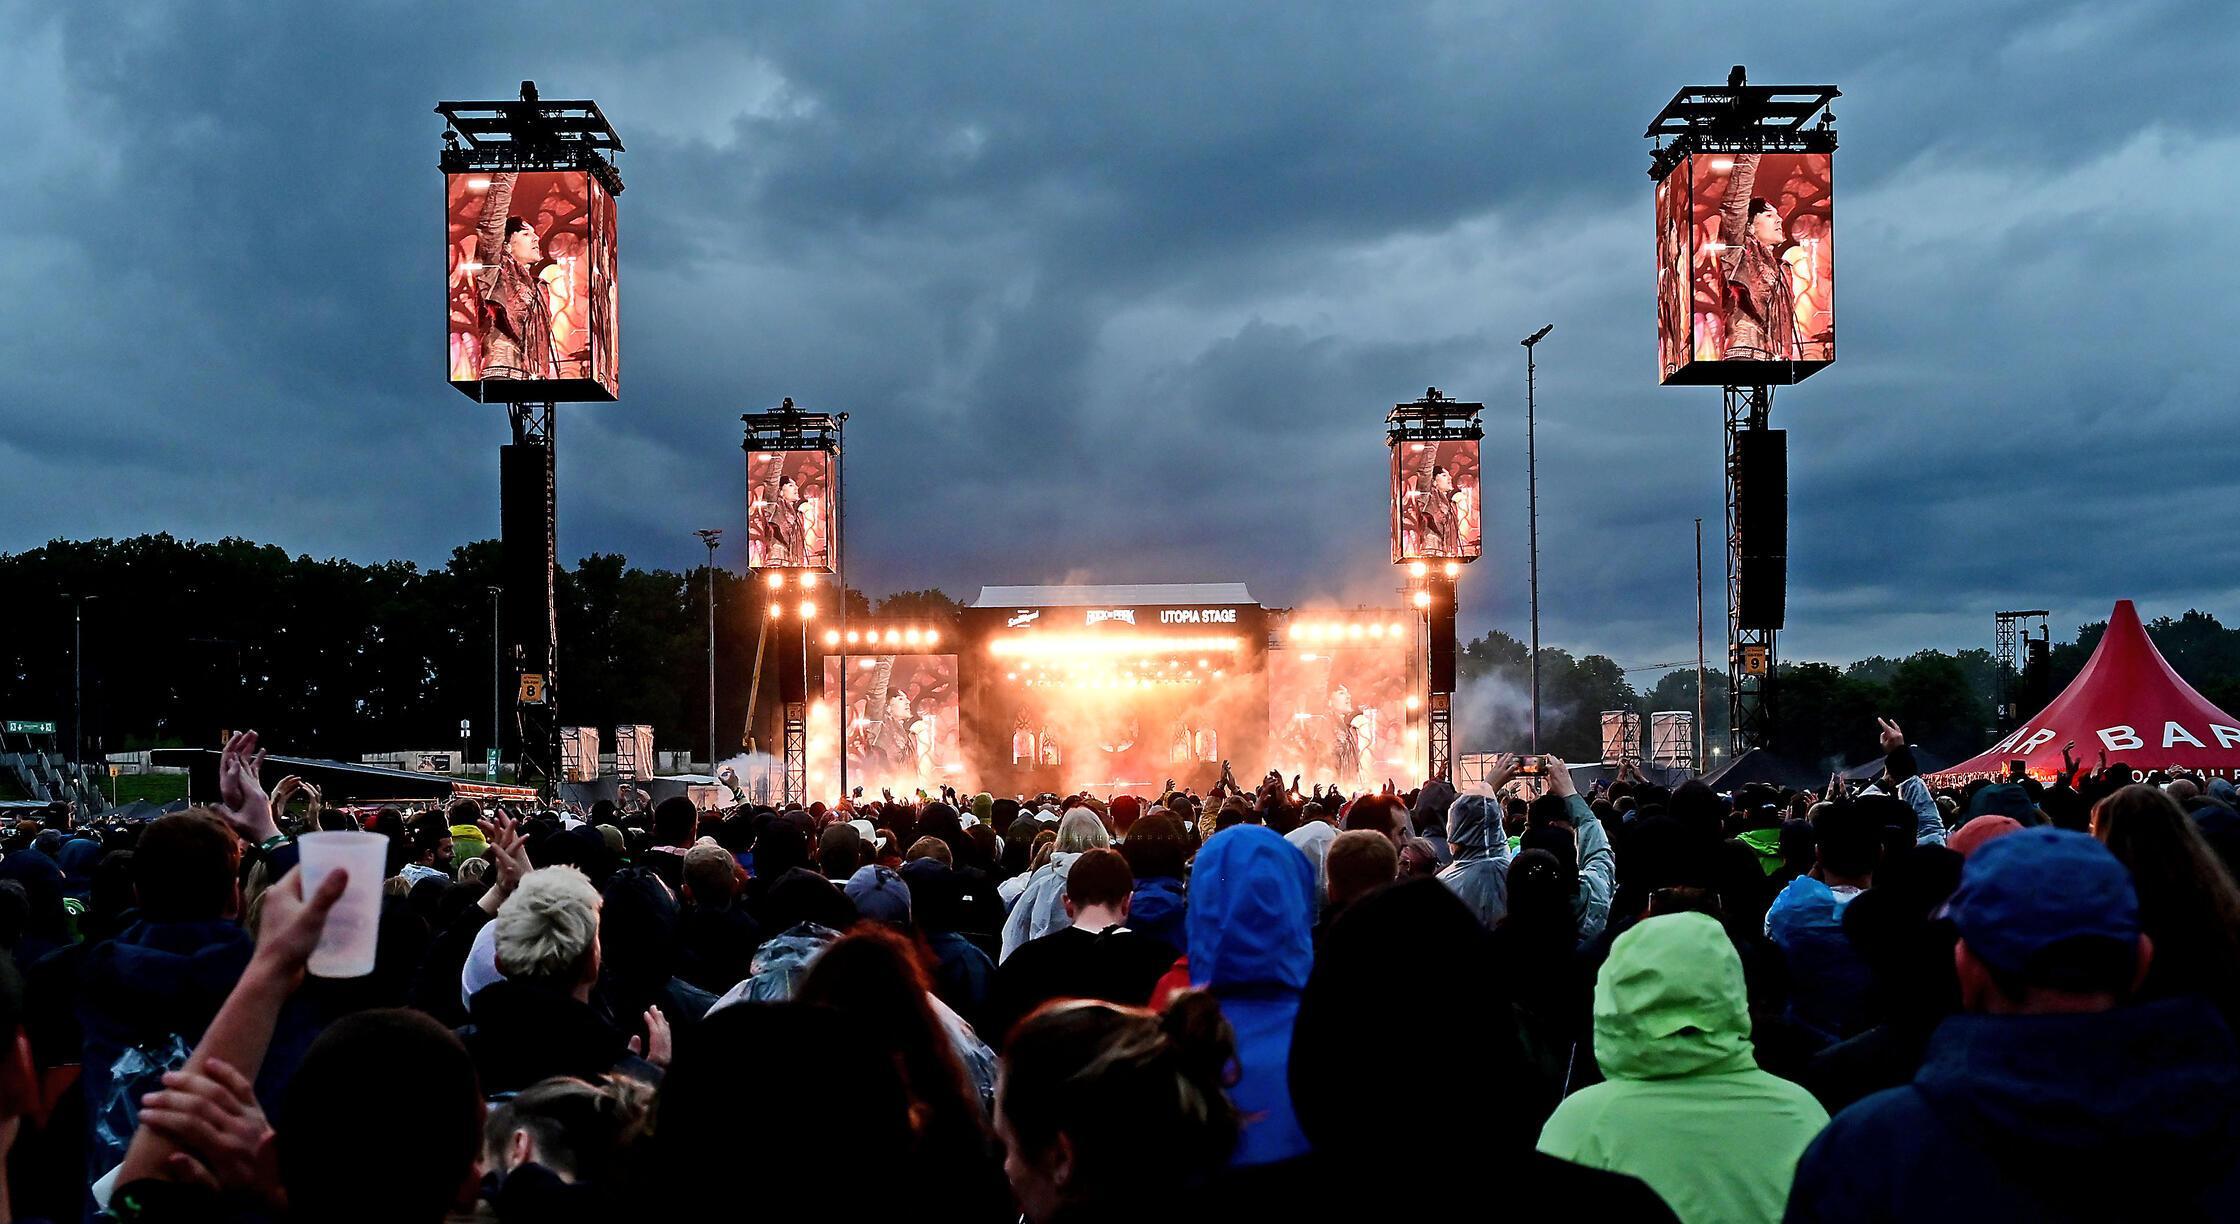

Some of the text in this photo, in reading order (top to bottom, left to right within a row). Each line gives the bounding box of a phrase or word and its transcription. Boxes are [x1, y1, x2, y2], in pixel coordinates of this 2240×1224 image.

[1160, 609, 1237, 624] UTOPIA STAGE
[1750, 657, 1760, 669] 9
[526, 685, 536, 697] 8
[1988, 727, 2057, 755] AR
[2097, 721, 2240, 752] BAR
